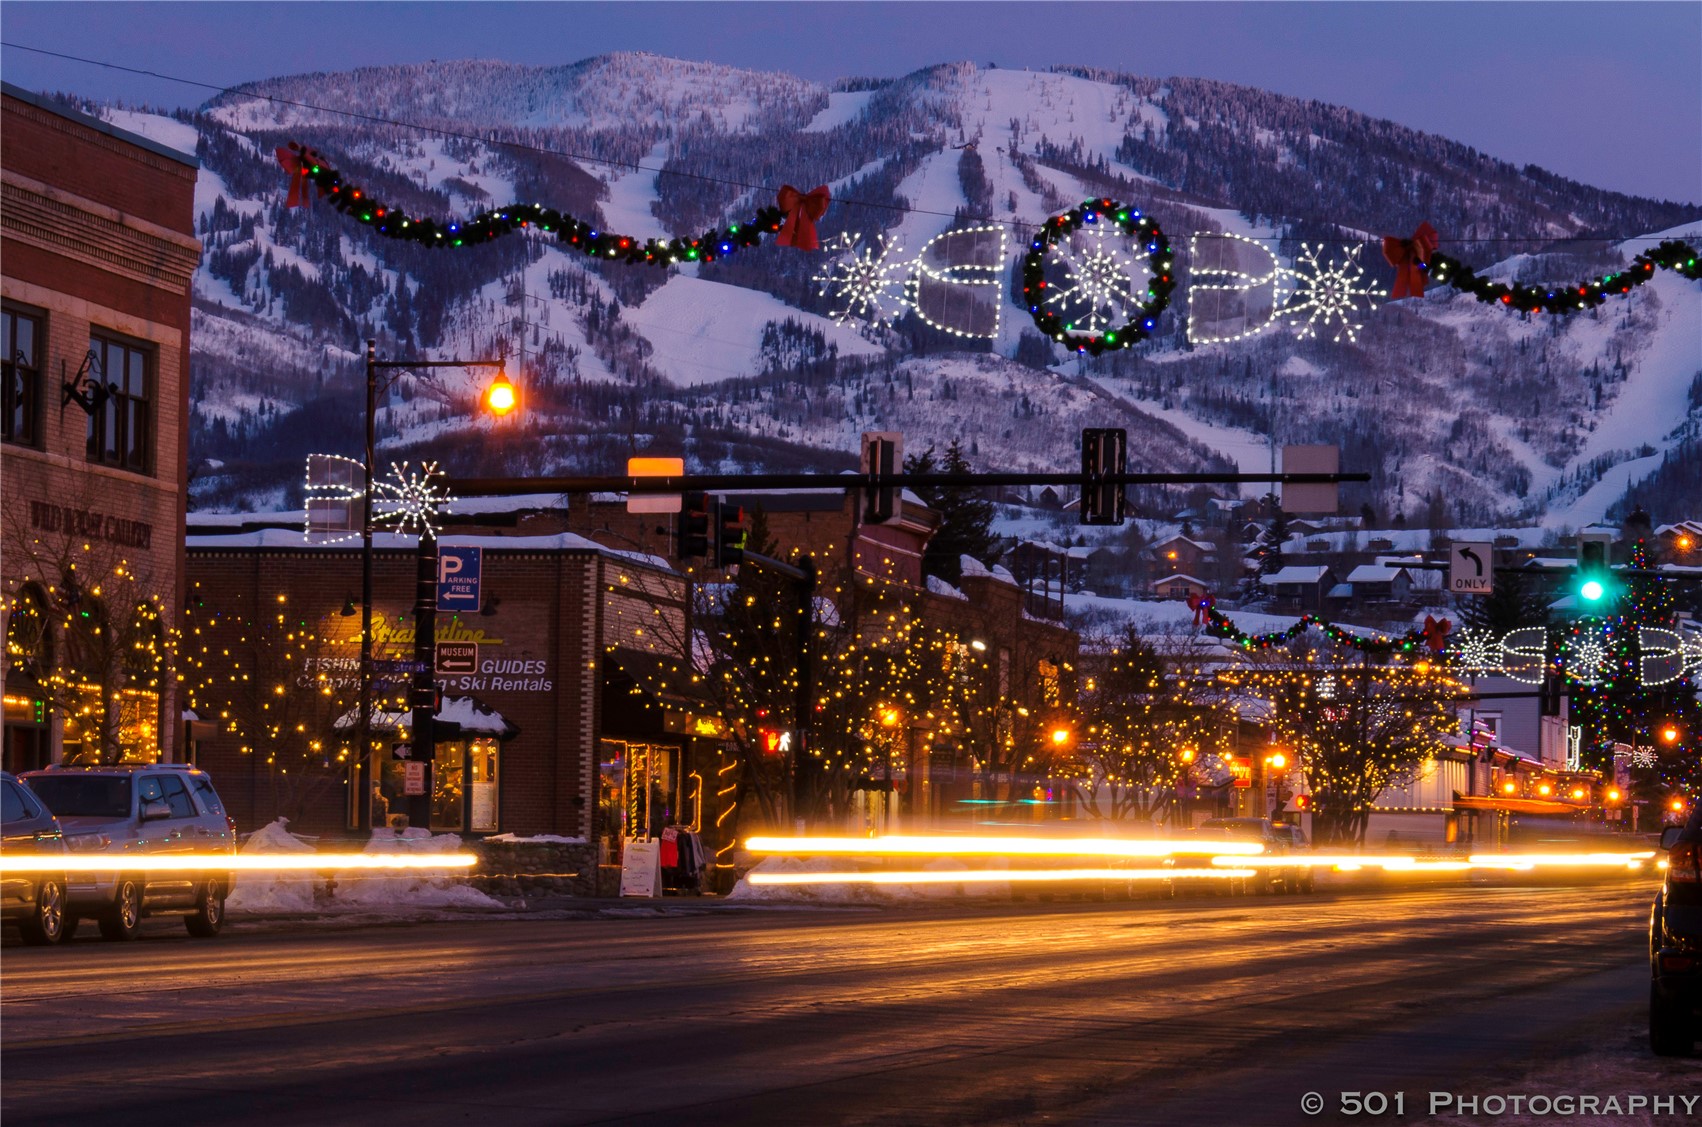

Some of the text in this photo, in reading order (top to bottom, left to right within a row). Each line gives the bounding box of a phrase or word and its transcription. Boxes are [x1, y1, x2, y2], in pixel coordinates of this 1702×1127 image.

[1455, 578, 1487, 589] ONLY
[440, 647, 474, 657] MUSEUM
[481, 659, 547, 675] GUIDES
[459, 676, 488, 691] Ski
[491, 676, 554, 692] Rentals
